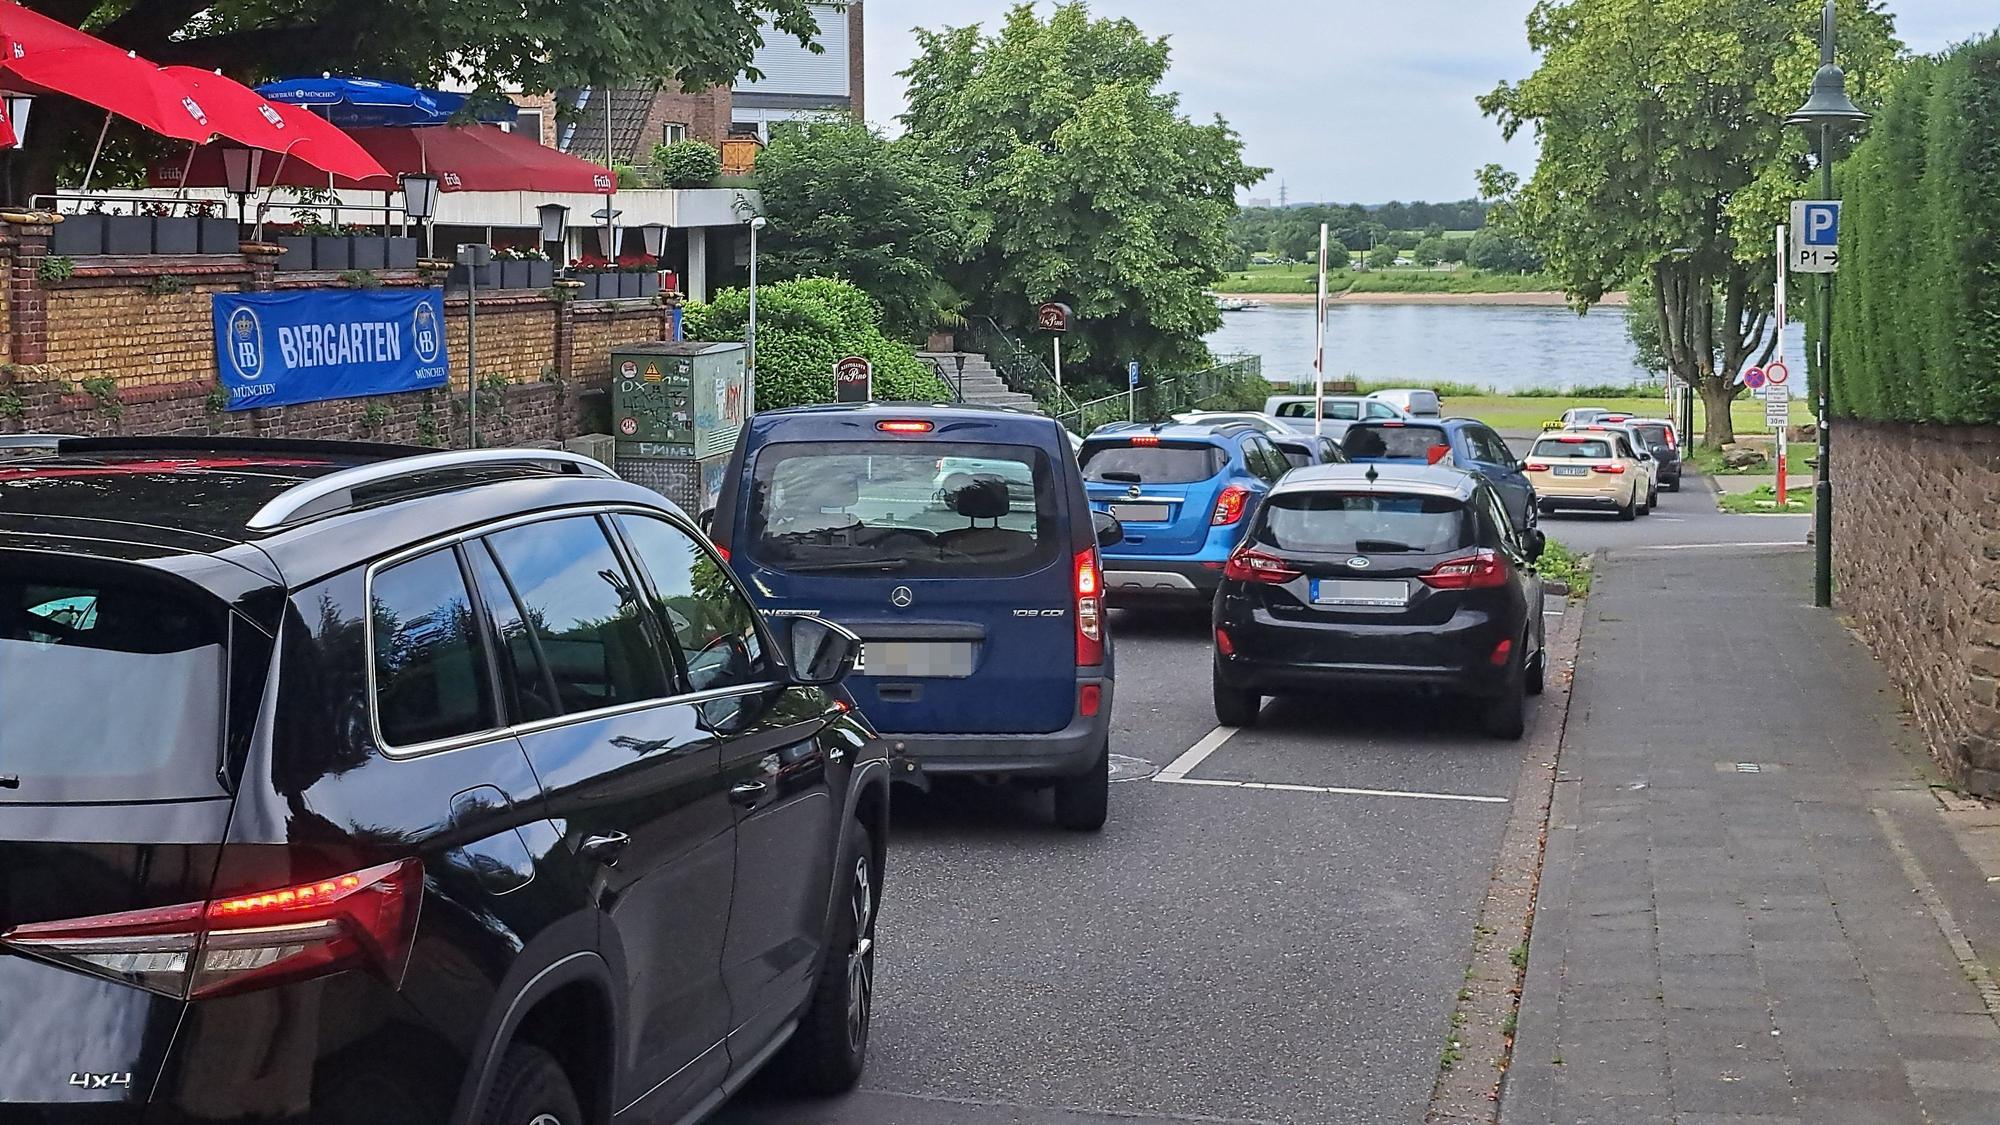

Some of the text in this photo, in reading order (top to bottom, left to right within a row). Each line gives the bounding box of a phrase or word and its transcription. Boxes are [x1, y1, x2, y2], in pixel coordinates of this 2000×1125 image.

[304, 90, 337, 99] MÜNCHEN
[593, 174, 611, 189] früh
[1809, 208, 1833, 242] P
[1800, 250, 1817, 266] P1
[278, 322, 401, 369] BIERGARTEN
[415, 367, 446, 380] MÜNCHEN
[232, 382, 276, 399] MÜNCHEN
[1012, 609, 1065, 617] 109 CDI
[69, 1072, 131, 1089] 4x4
